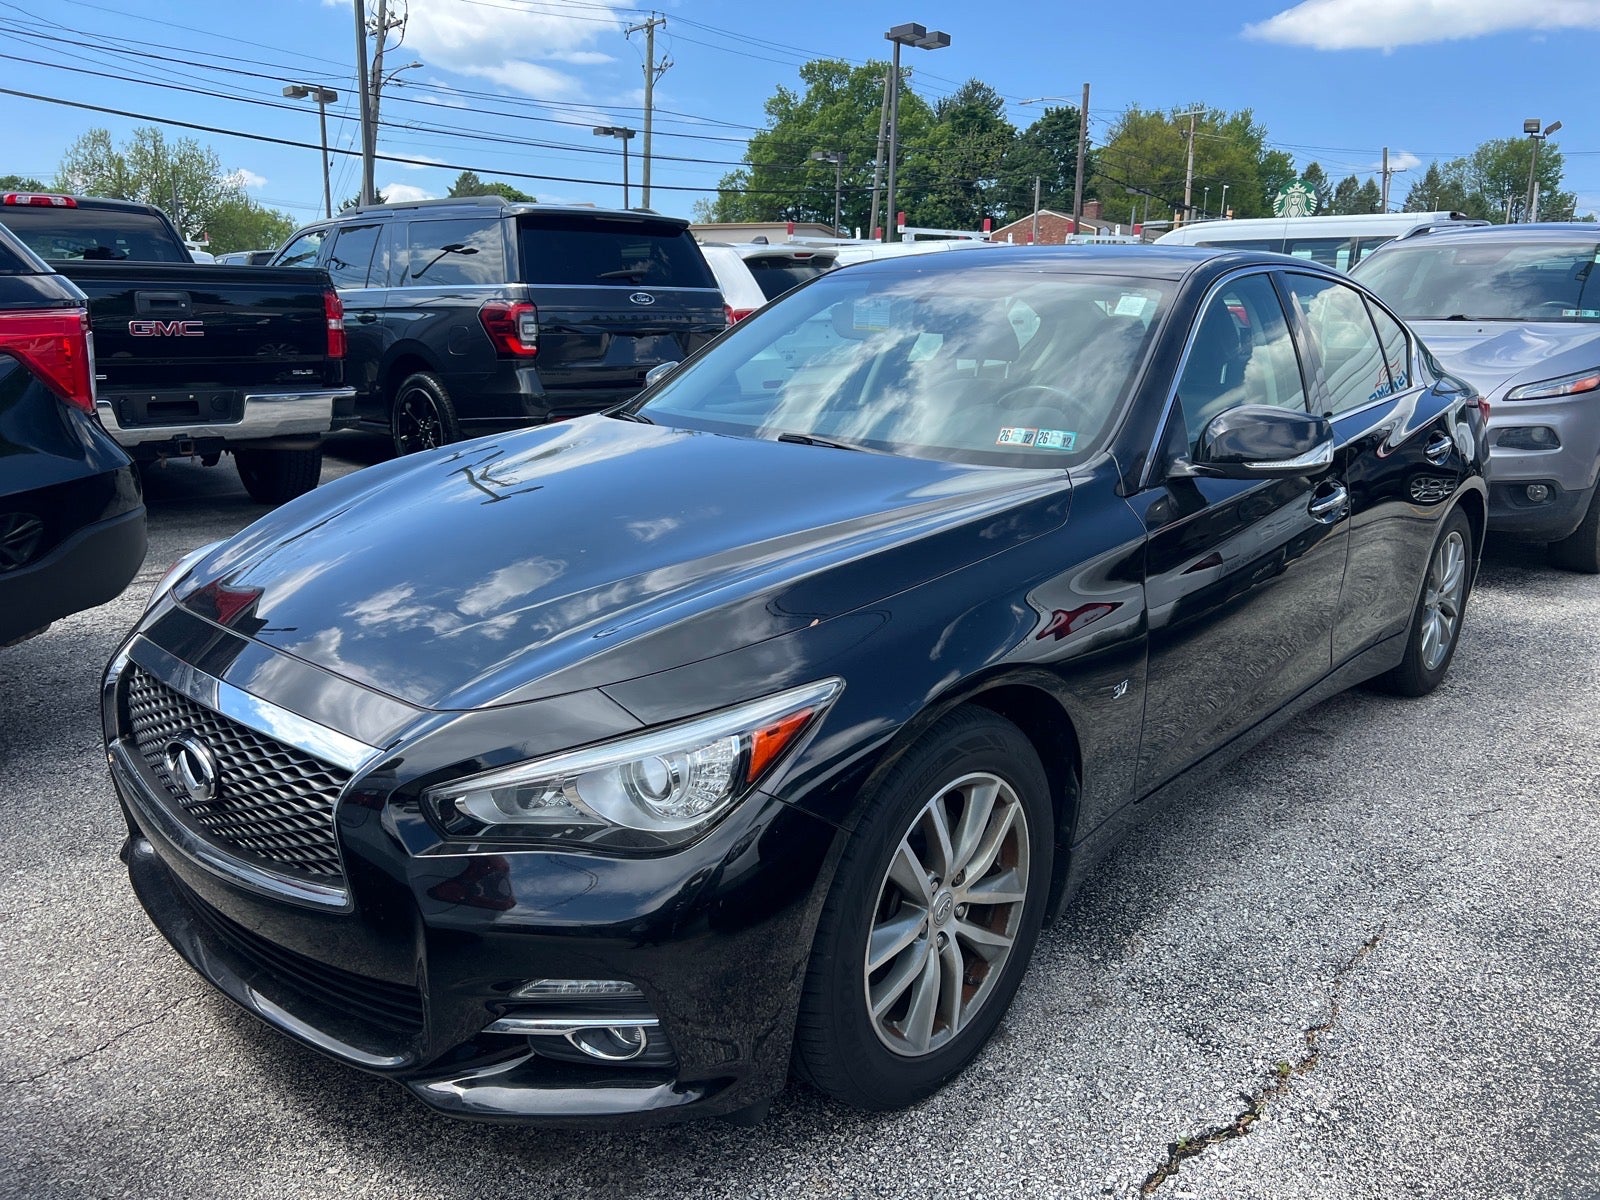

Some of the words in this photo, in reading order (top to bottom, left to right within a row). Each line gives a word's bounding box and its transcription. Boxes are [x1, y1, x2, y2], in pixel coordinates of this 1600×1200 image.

[128, 320, 205, 337] GMC
[999, 429, 1011, 442] 26
[1023, 433, 1034, 444] 12
[1038, 431, 1050, 444] 26
[1063, 436, 1072, 448] 12
